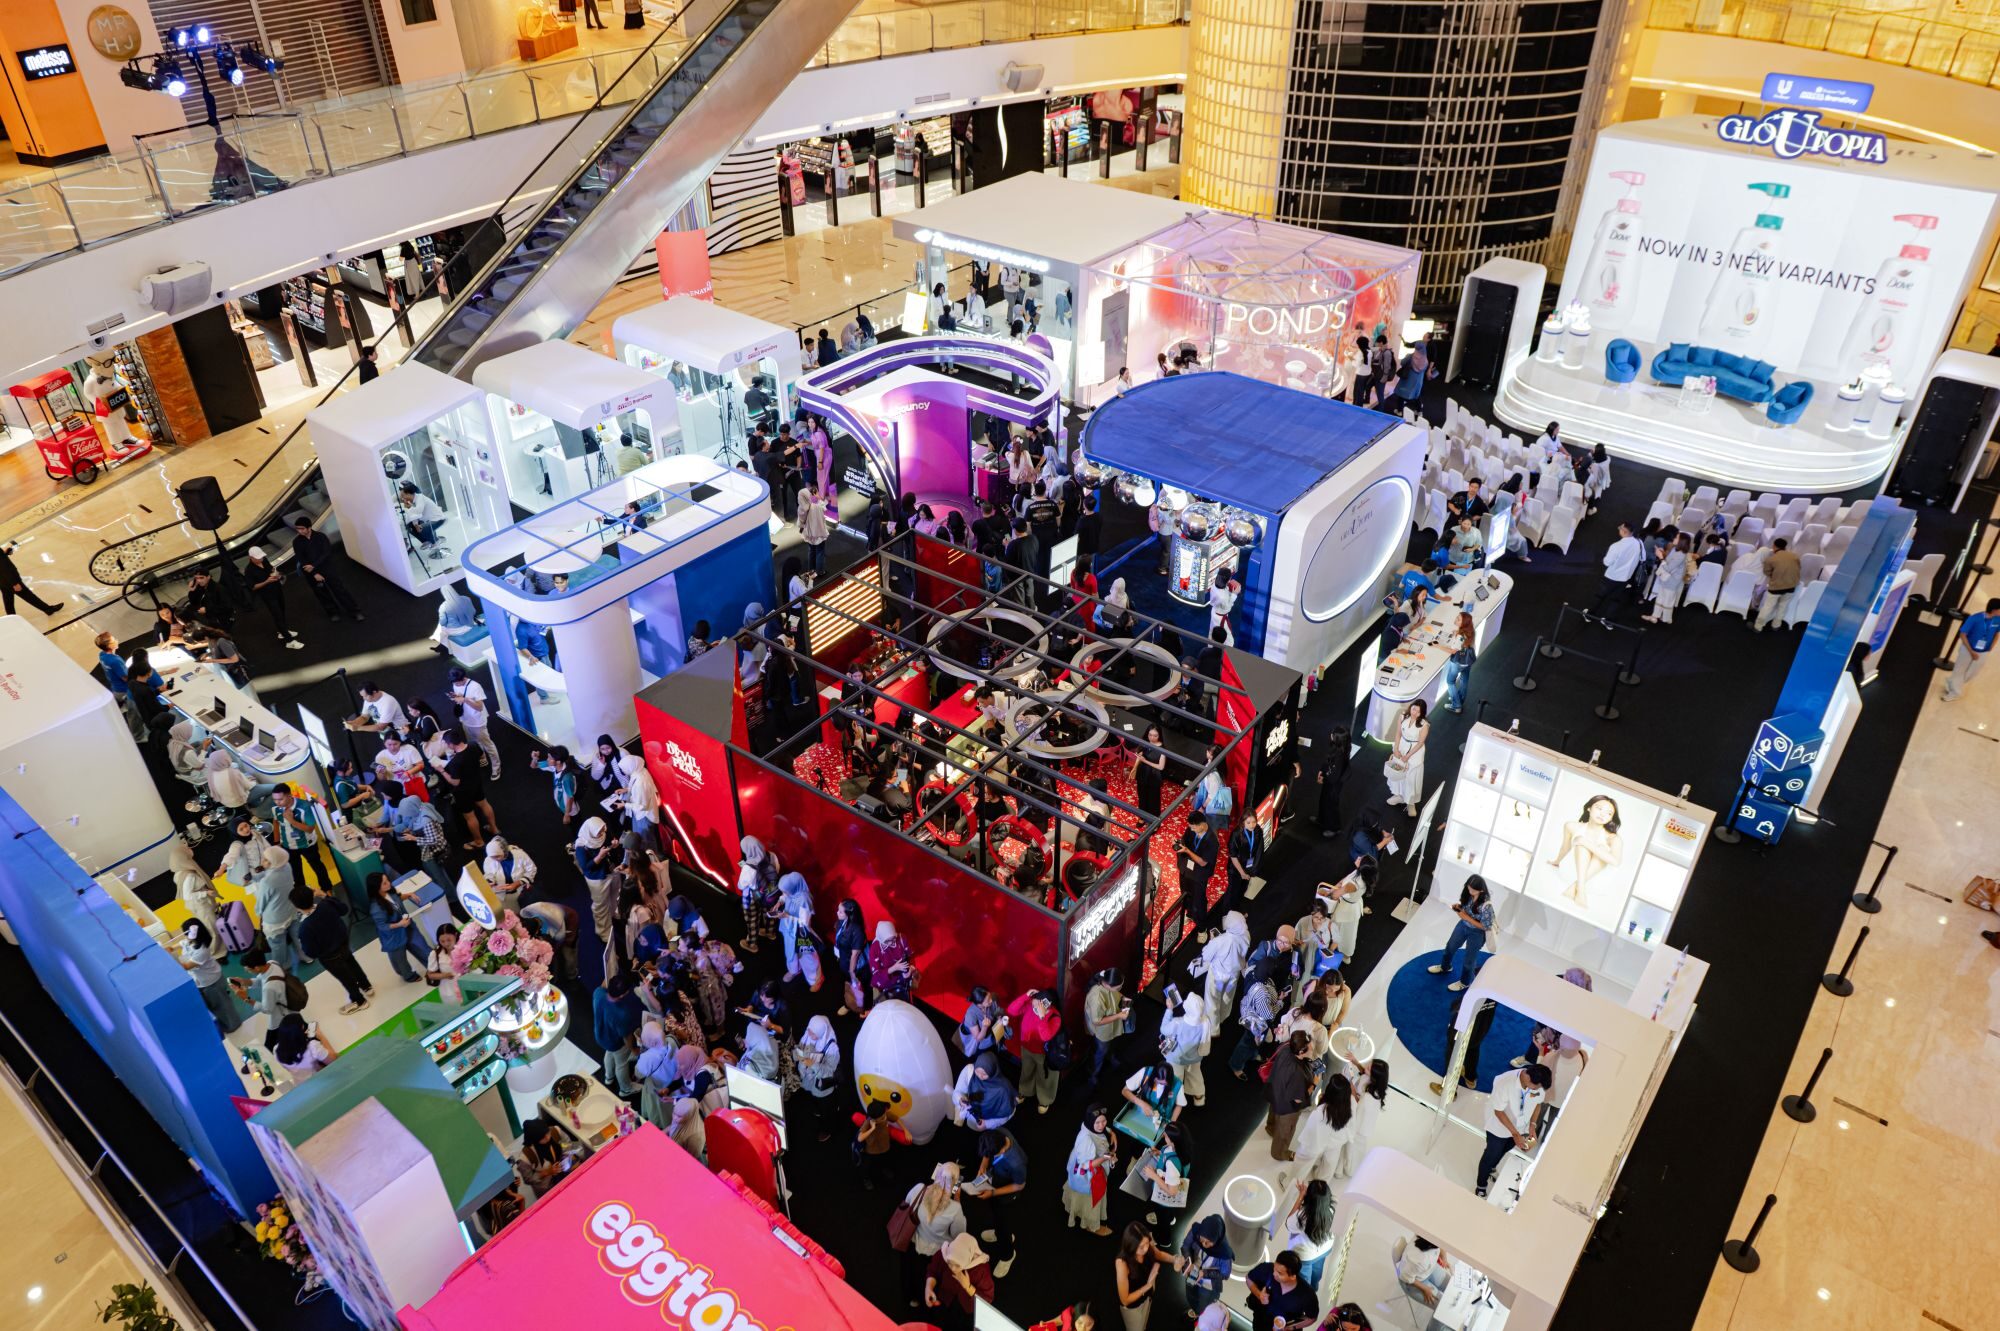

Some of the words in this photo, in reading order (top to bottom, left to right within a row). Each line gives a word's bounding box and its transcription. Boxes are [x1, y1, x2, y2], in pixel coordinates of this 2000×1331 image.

[96, 14, 128, 32] MR
[103, 34, 134, 53] HJ
[25, 49, 70, 71] melissa
[1609, 229, 1631, 242] Dove
[1638, 236, 1685, 259] NOW
[1688, 245, 1708, 264] IN
[1712, 251, 1723, 266] 3
[1728, 253, 1775, 275] NEW
[1778, 261, 1877, 295] VARIANTS
[1886, 278, 1914, 291] Dove
[1227, 299, 1348, 335] POND'S
[1520, 764, 1553, 783] Vaseline
[1072, 920, 1104, 959] HAIR
